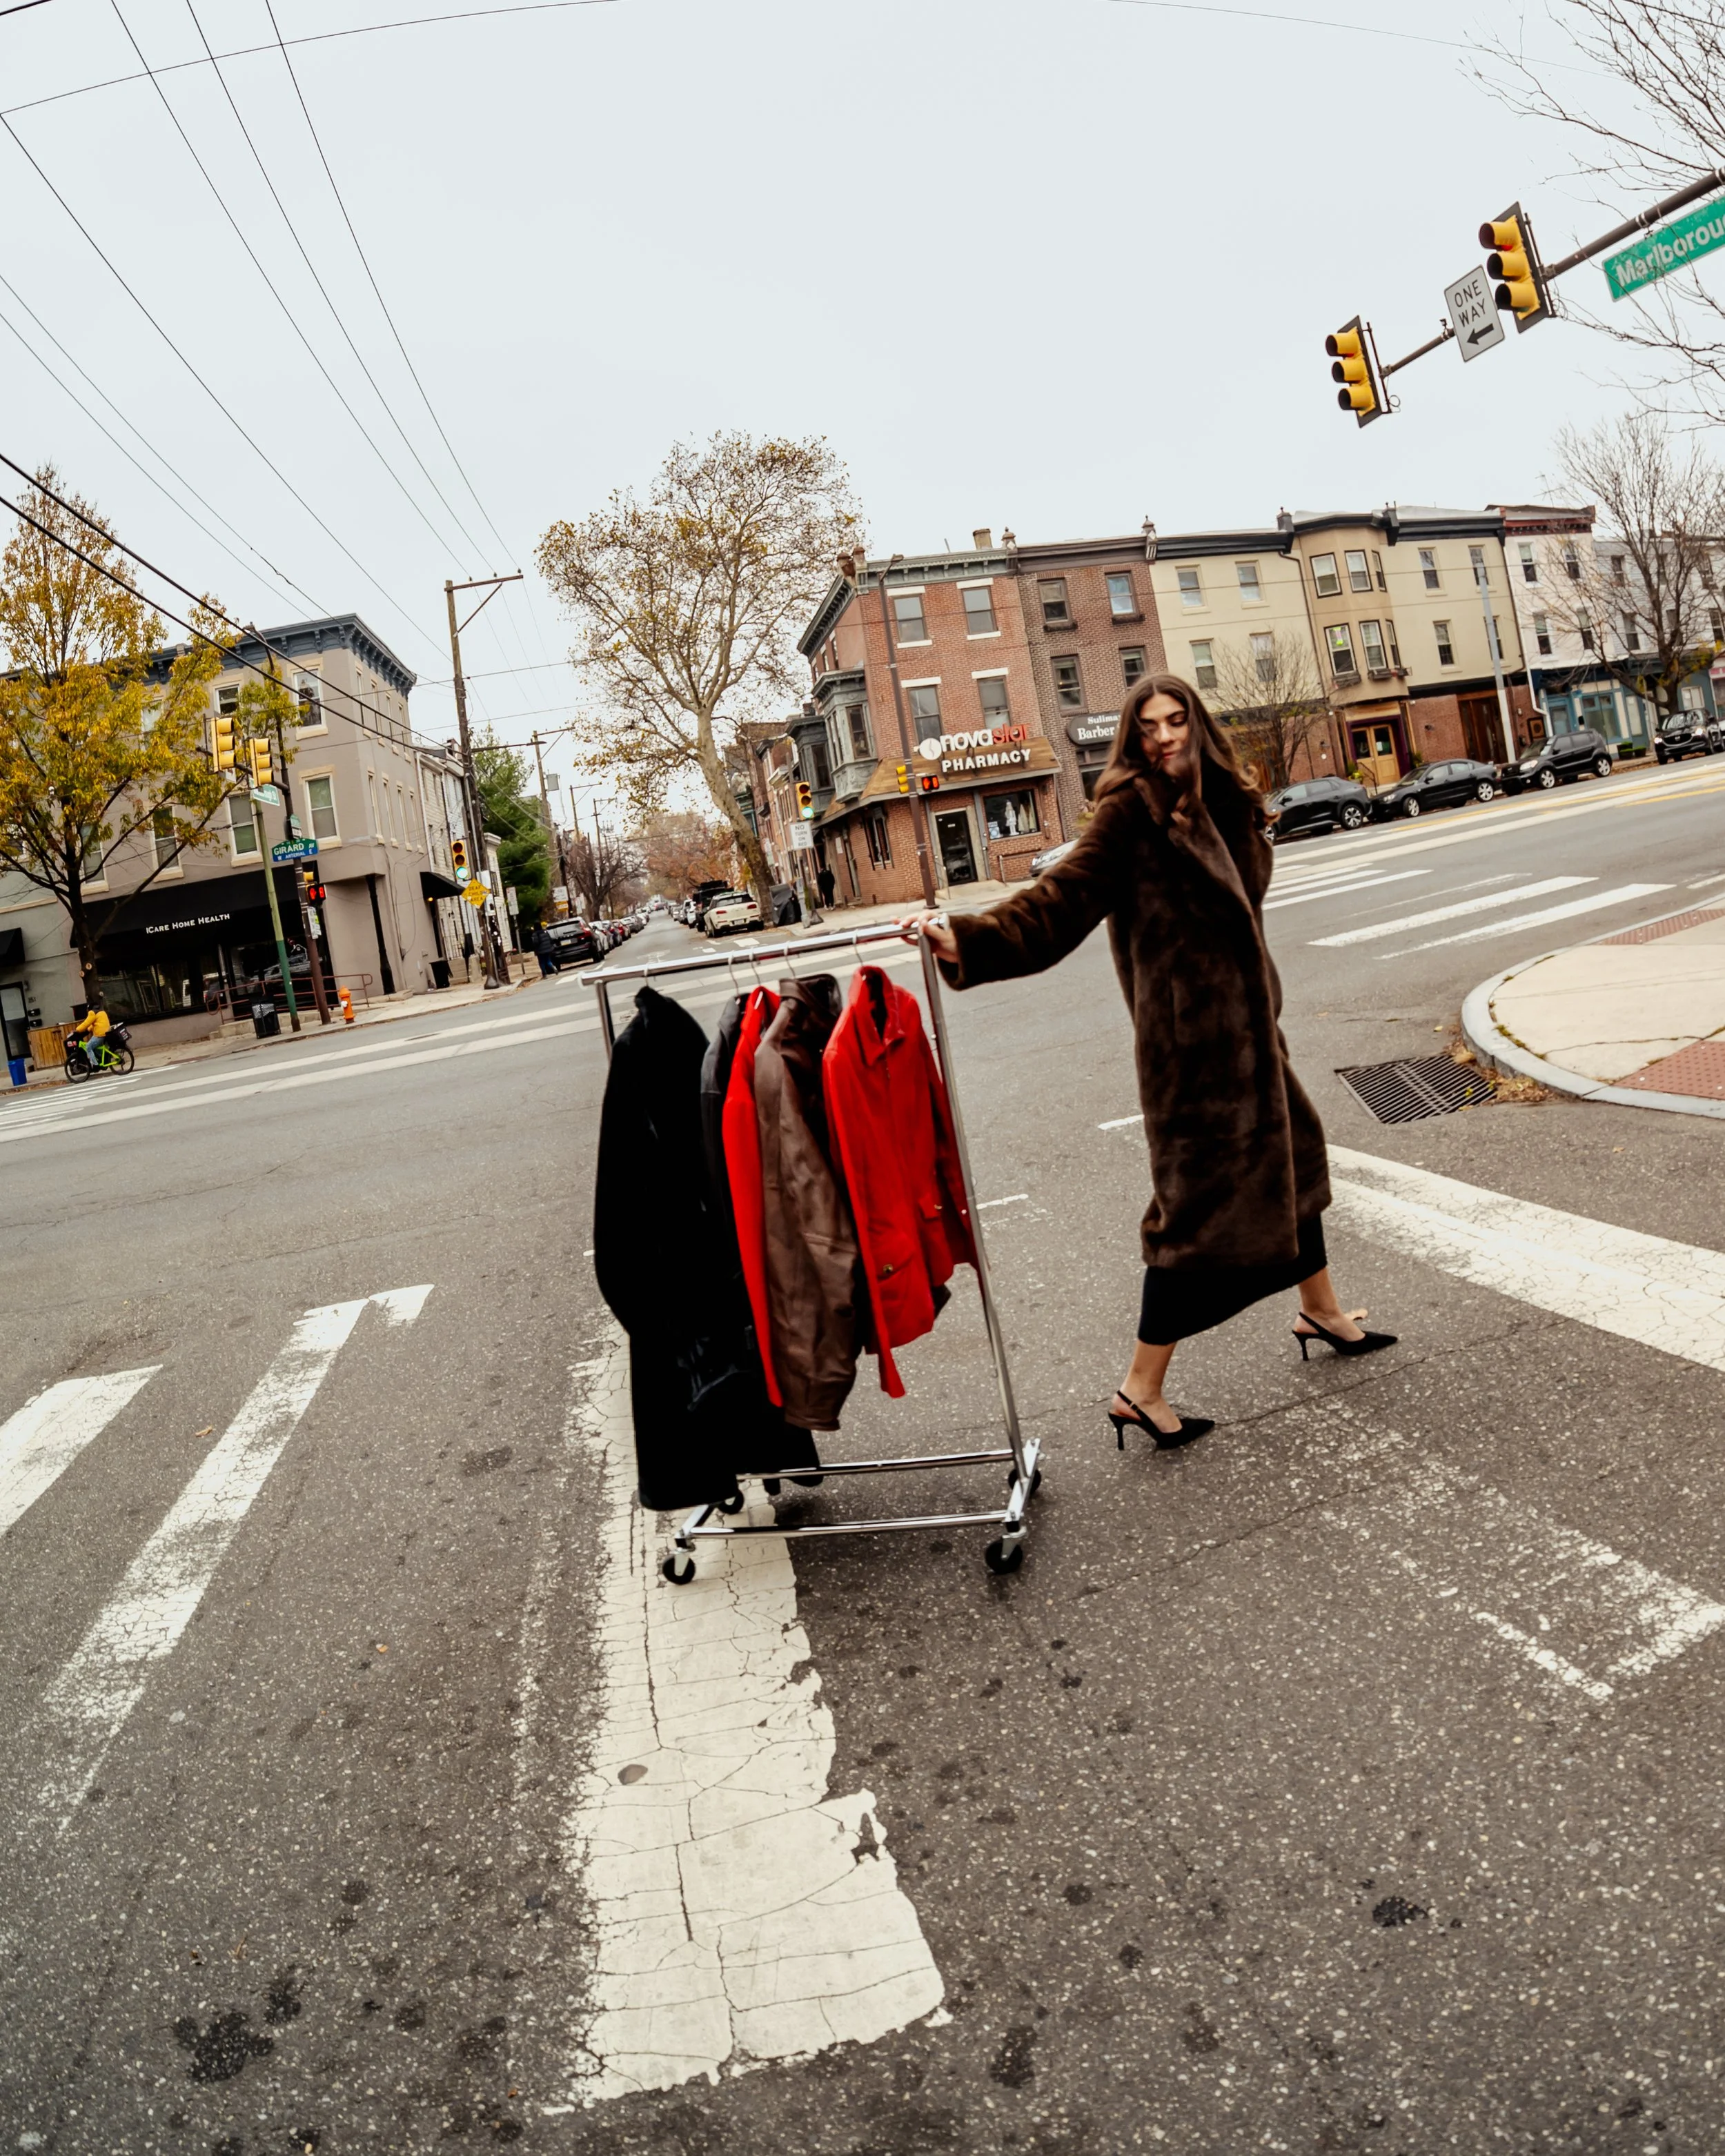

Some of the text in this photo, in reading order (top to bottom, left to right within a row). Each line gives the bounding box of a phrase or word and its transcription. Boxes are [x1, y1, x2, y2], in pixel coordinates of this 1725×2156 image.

[1615, 213, 1725, 286] Marlborou
[1455, 279, 1481, 307] ONE
[1458, 297, 1485, 327] WAY
[1087, 715, 1121, 724] Sulima
[939, 723, 1029, 752] novastar
[1077, 726, 1115, 740] Barber
[941, 749, 1031, 773] PHARMACY
[273, 843, 304, 856] GIRARD
